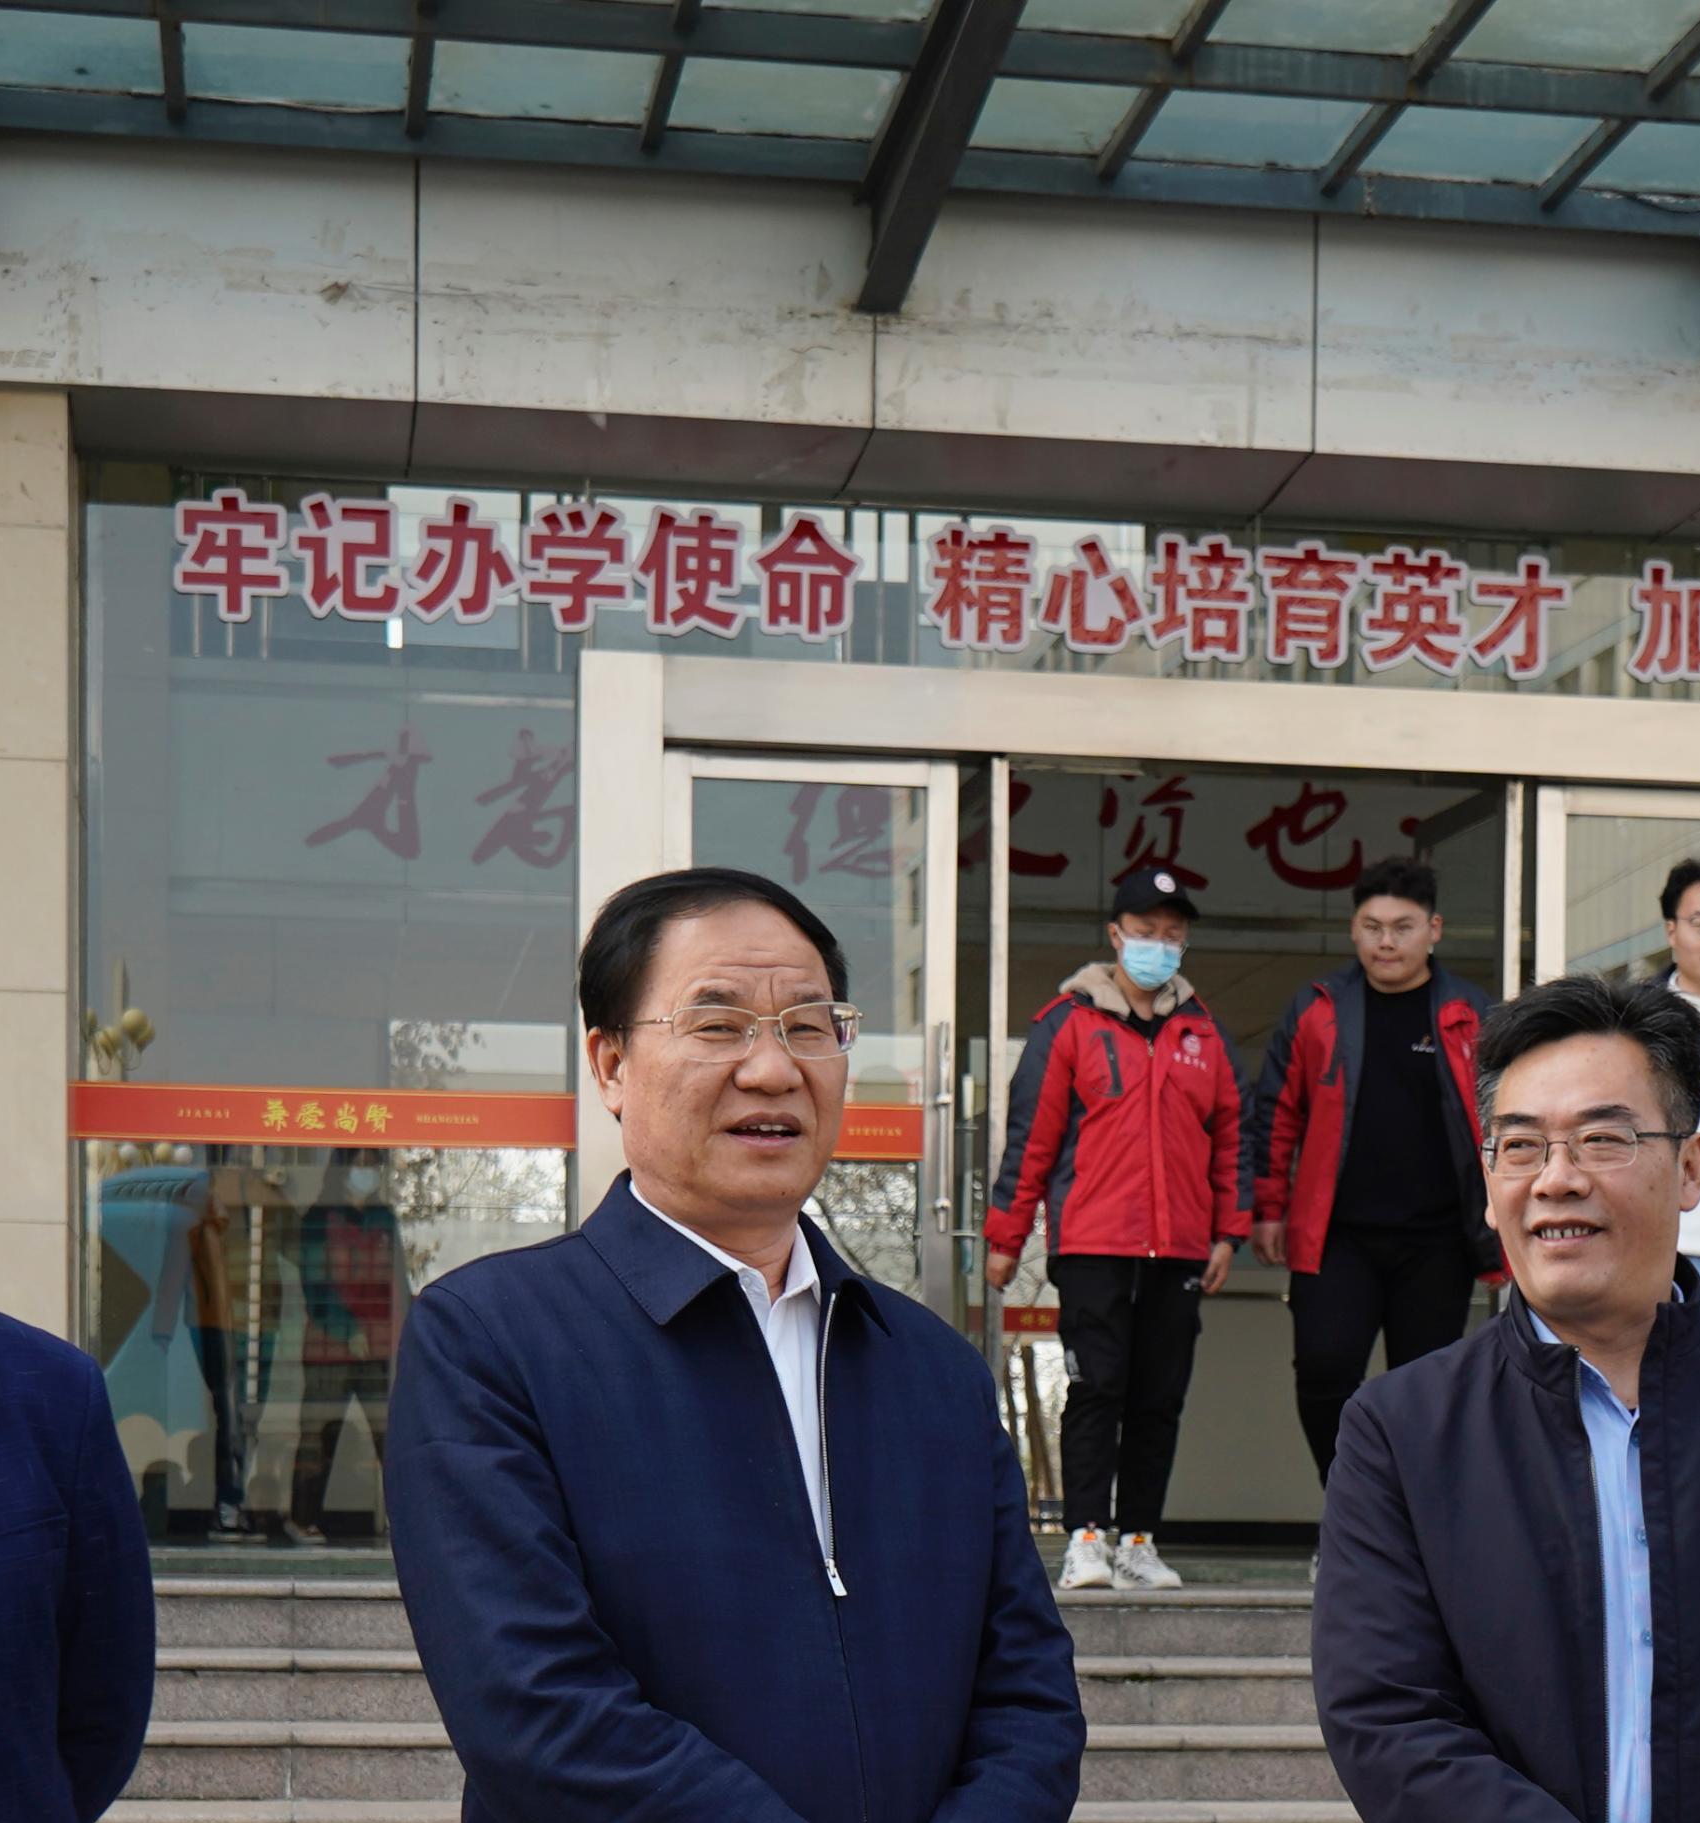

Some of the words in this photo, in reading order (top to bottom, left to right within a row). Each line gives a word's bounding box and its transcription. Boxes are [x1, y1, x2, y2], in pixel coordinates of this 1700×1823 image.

[175, 486, 864, 643] 牢记办学使命
[925, 520, 1570, 681] 精心培育英才
